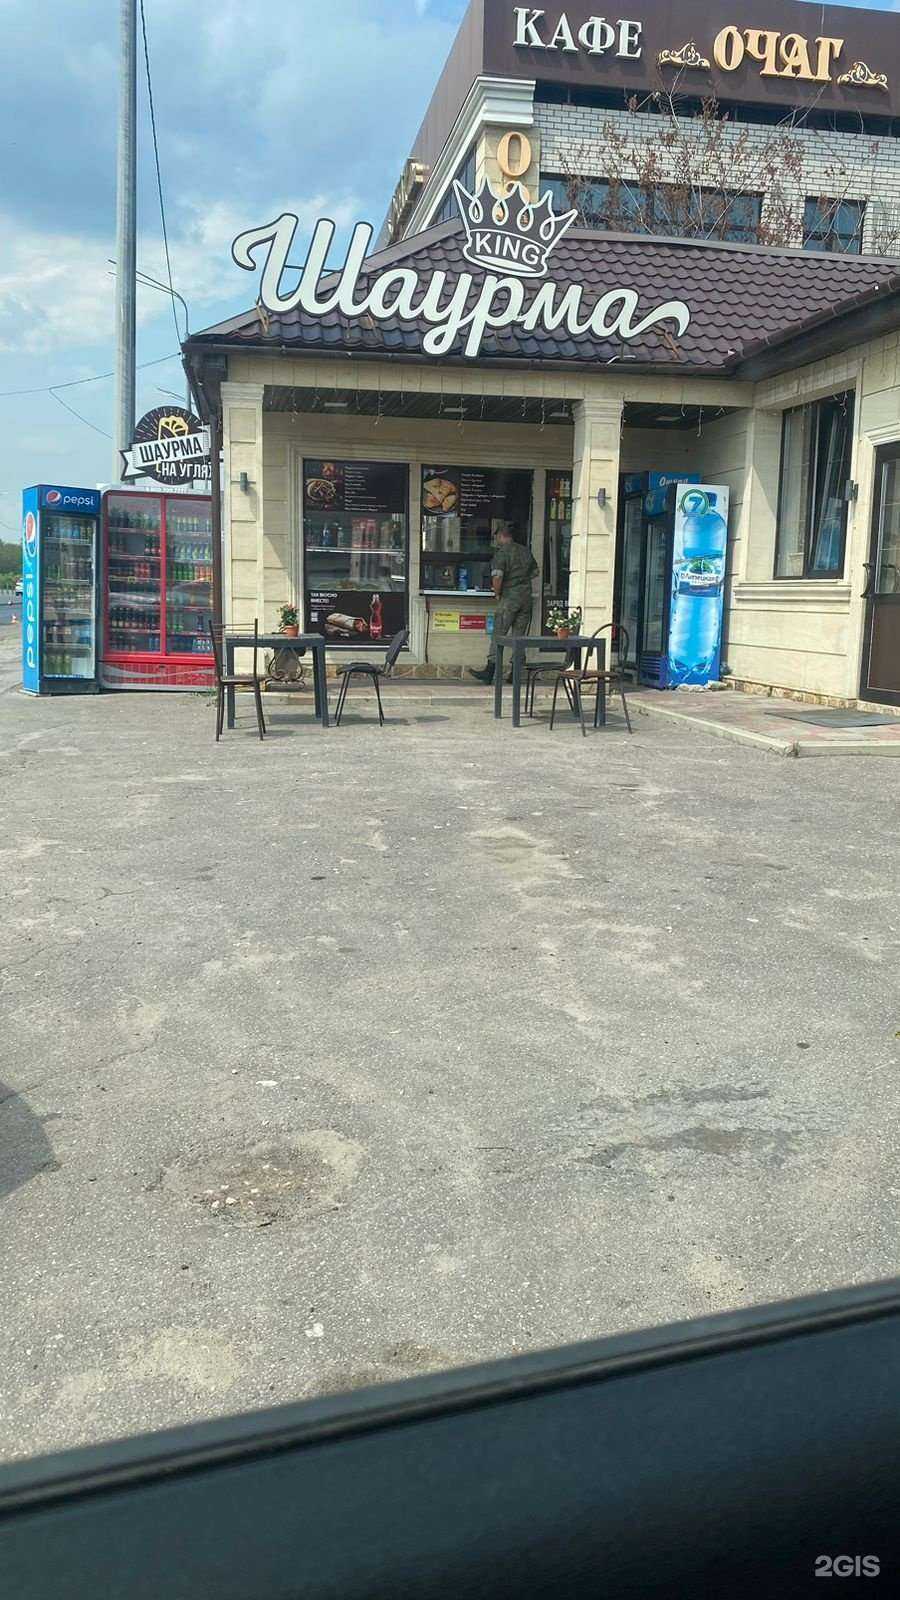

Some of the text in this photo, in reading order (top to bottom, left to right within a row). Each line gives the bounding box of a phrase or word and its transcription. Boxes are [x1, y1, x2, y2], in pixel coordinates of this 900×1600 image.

[512, 7, 643, 60] КАФЕ
[713, 25, 845, 82] ОЧАГ
[475, 232, 541, 265] KING
[231, 211, 691, 358] Шаурма
[139, 437, 203, 463] ШАУРМА
[161, 462, 177, 477] НА
[63, 495, 96, 507] pepsi
[25, 573, 36, 669] pepsi
